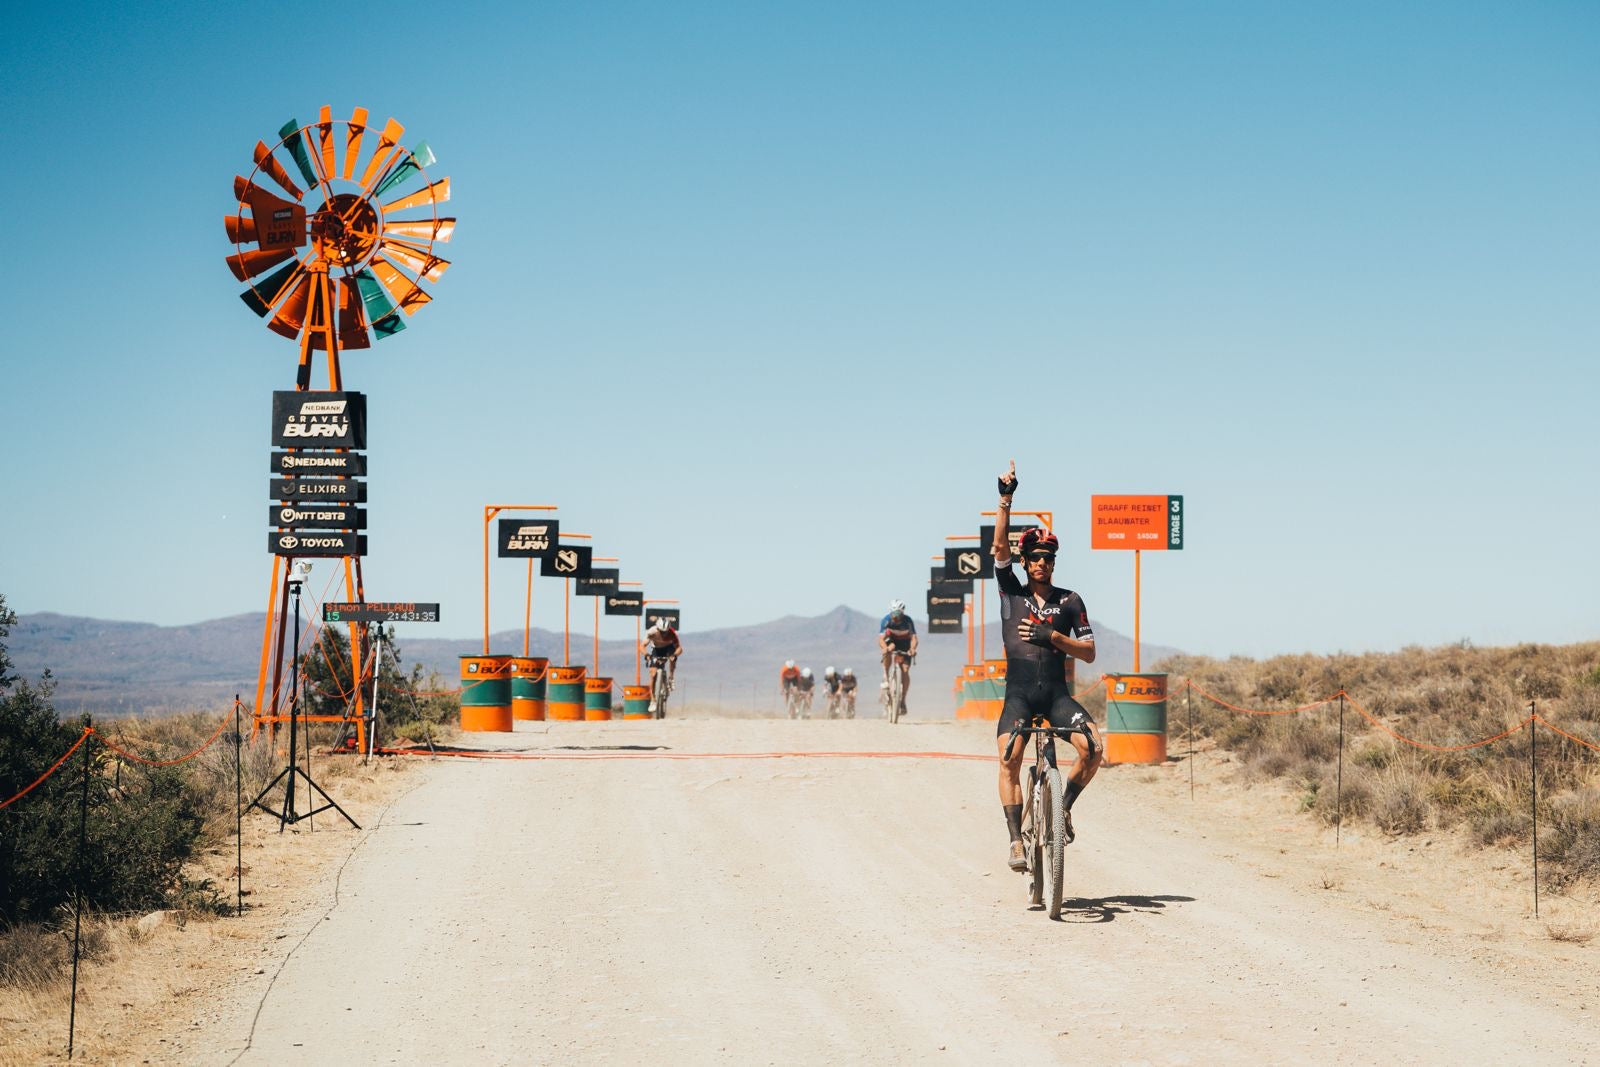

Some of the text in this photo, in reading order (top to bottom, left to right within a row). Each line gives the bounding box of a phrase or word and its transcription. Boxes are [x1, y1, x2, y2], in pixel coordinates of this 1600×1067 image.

[288, 415, 349, 423] GRAVEL
[282, 423, 349, 437] BURN
[295, 458, 347, 467] NEDBANK
[299, 484, 347, 493] ELIXIRR
[1097, 504, 1162, 512] GRAAFF REINET
[295, 512, 317, 520] NTT
[1097, 517, 1150, 525] BLAAUWATER
[1171, 500, 1180, 545] STAGE 3
[300, 538, 344, 547] TOYOTA
[507, 540, 549, 550] BURN
[325, 603, 416, 612] Simon PELLAUD
[1024, 598, 1061, 616] TUDOR
[325, 611, 436, 621] 15 2:43:35
[1129, 687, 1165, 696] BURN
